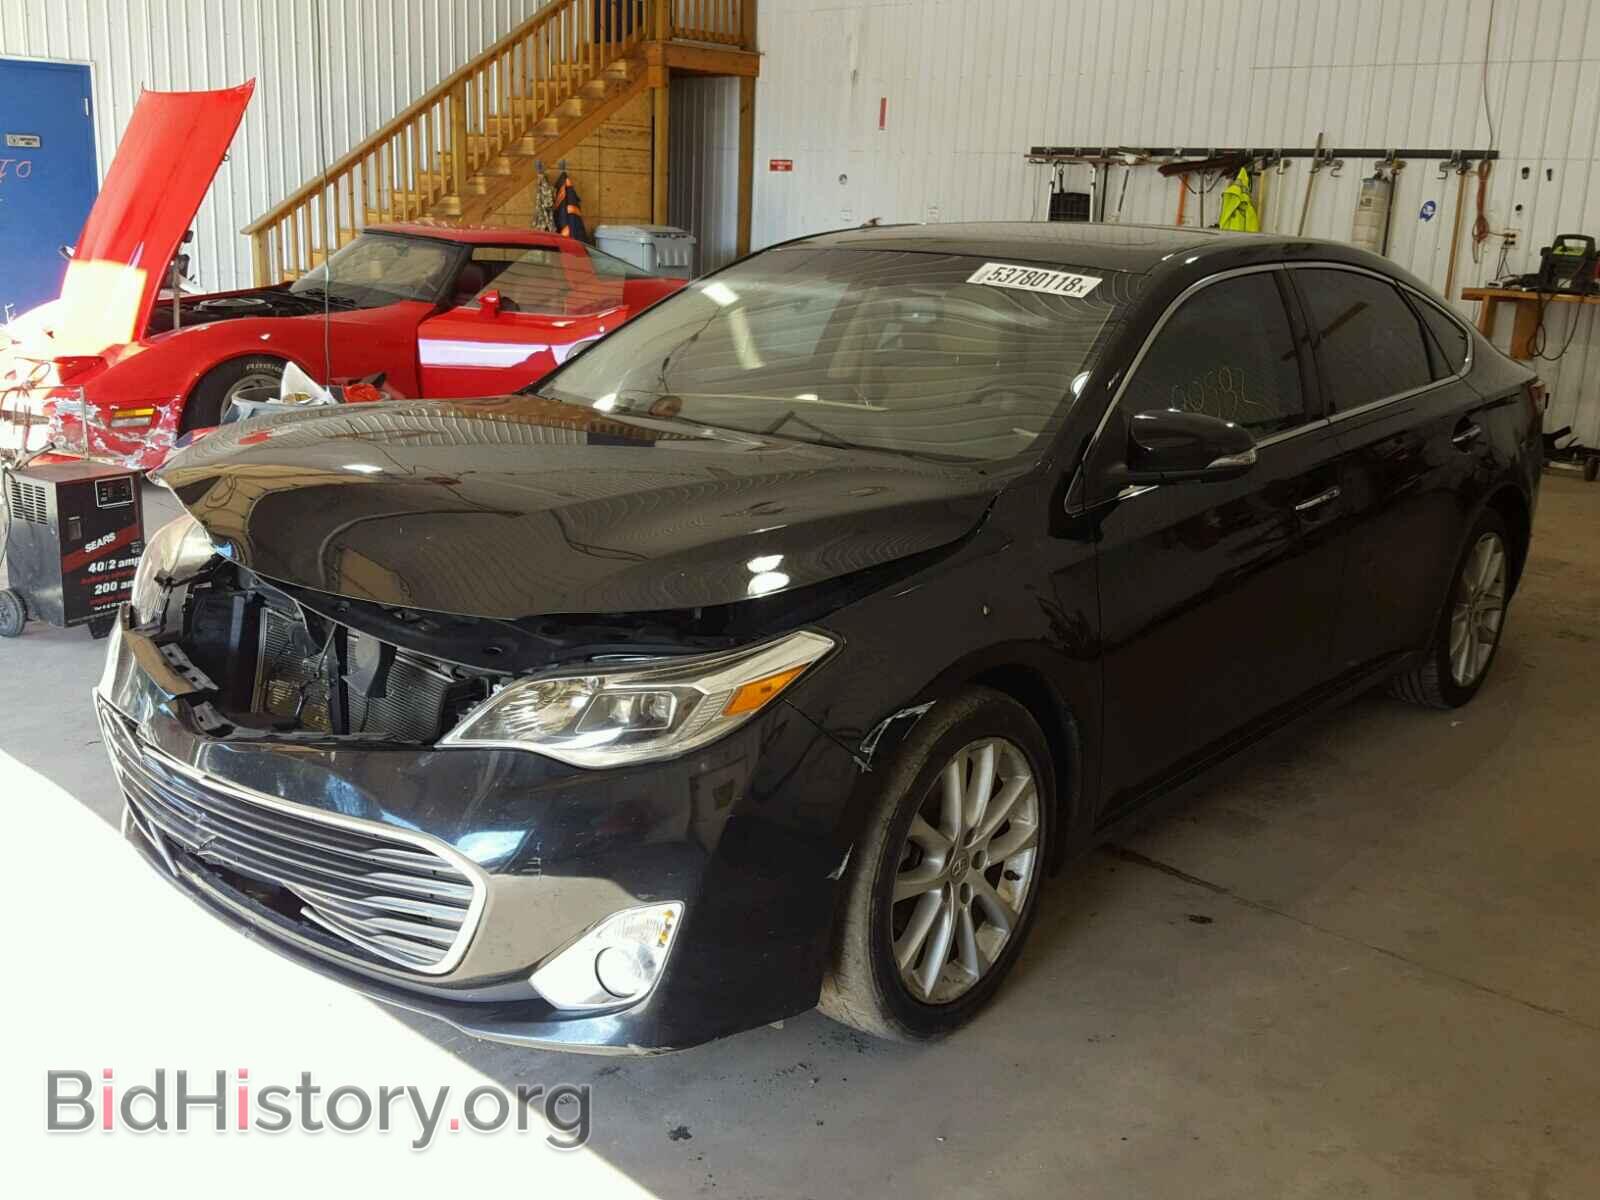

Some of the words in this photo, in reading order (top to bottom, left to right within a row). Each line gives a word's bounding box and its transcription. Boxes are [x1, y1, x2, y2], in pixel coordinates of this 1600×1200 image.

[85, 532, 116, 552] SEARS
[88, 559, 116, 573] 40/2
[95, 581, 117, 595] 200
